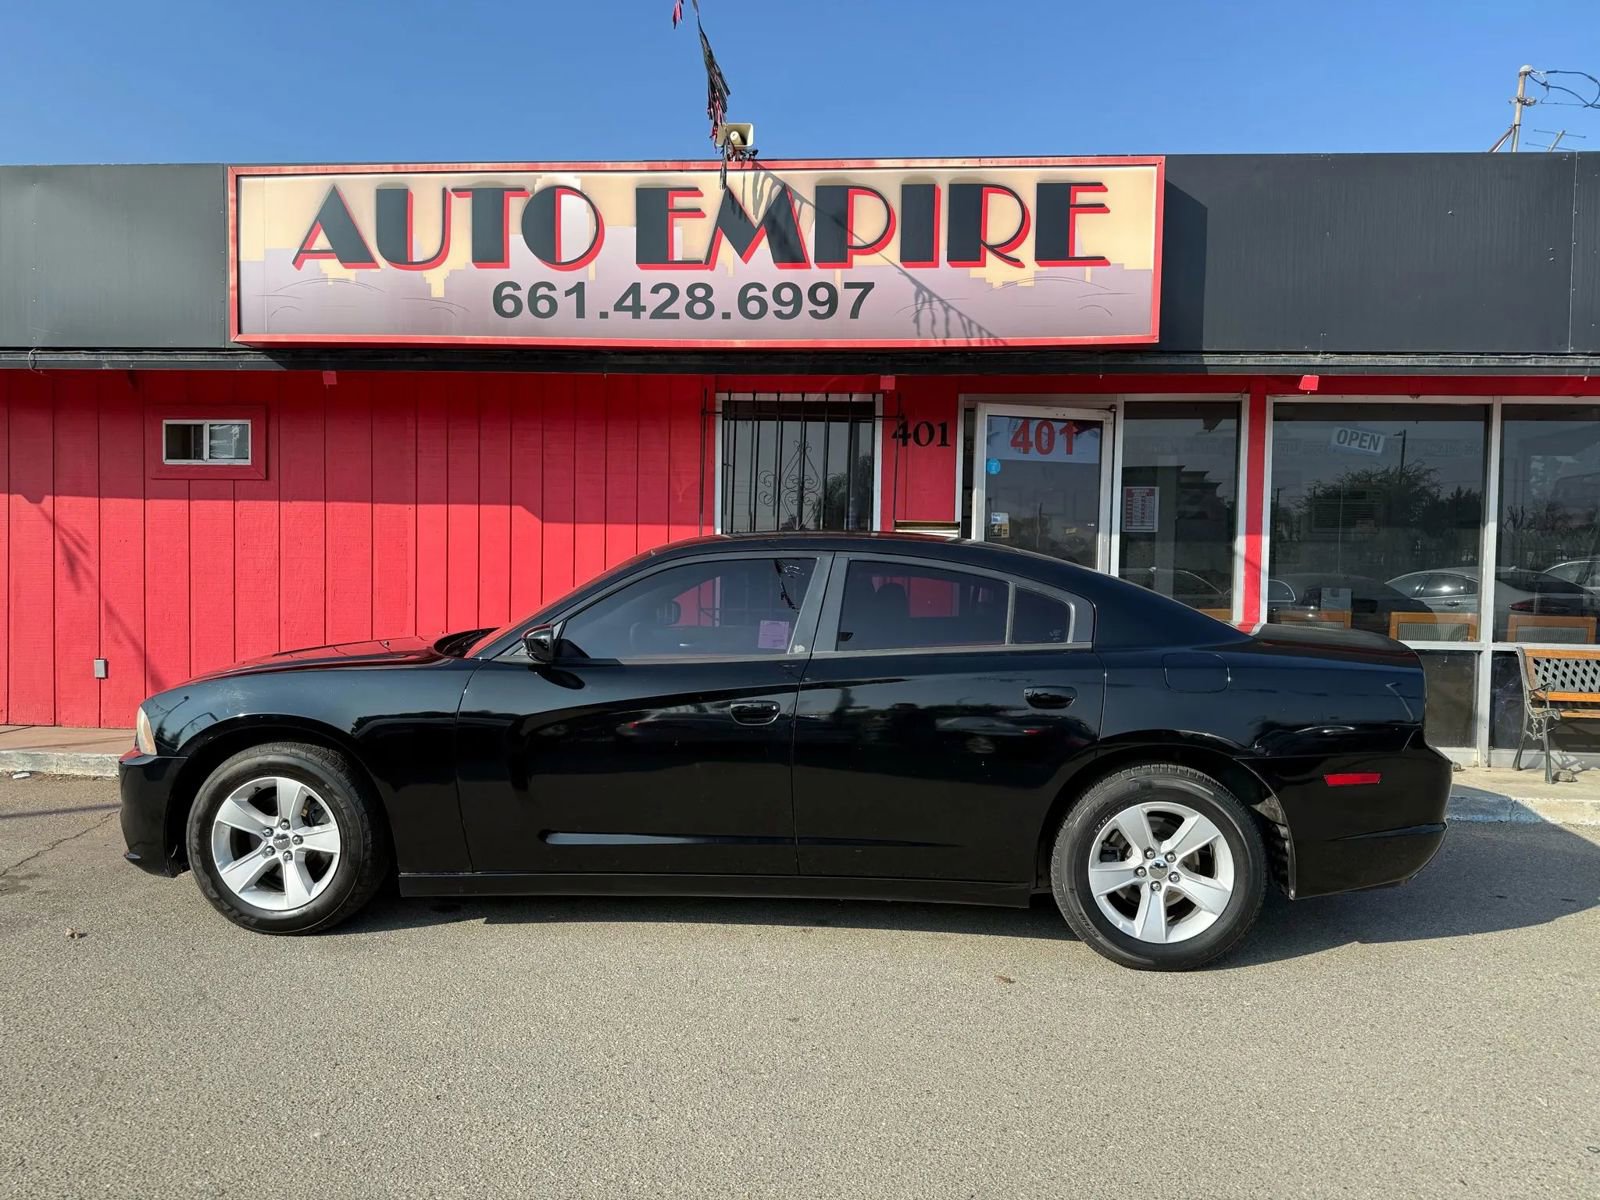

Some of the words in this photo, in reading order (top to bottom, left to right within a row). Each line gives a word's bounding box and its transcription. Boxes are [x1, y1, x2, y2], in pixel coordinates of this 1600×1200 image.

[292, 184, 605, 271] AUTO
[635, 182, 1111, 270] EMPIRE
[492, 281, 876, 320] 661.428.6997
[891, 420, 950, 447] 401
[1010, 418, 1078, 455] 401
[1336, 429, 1381, 451] OPEN
